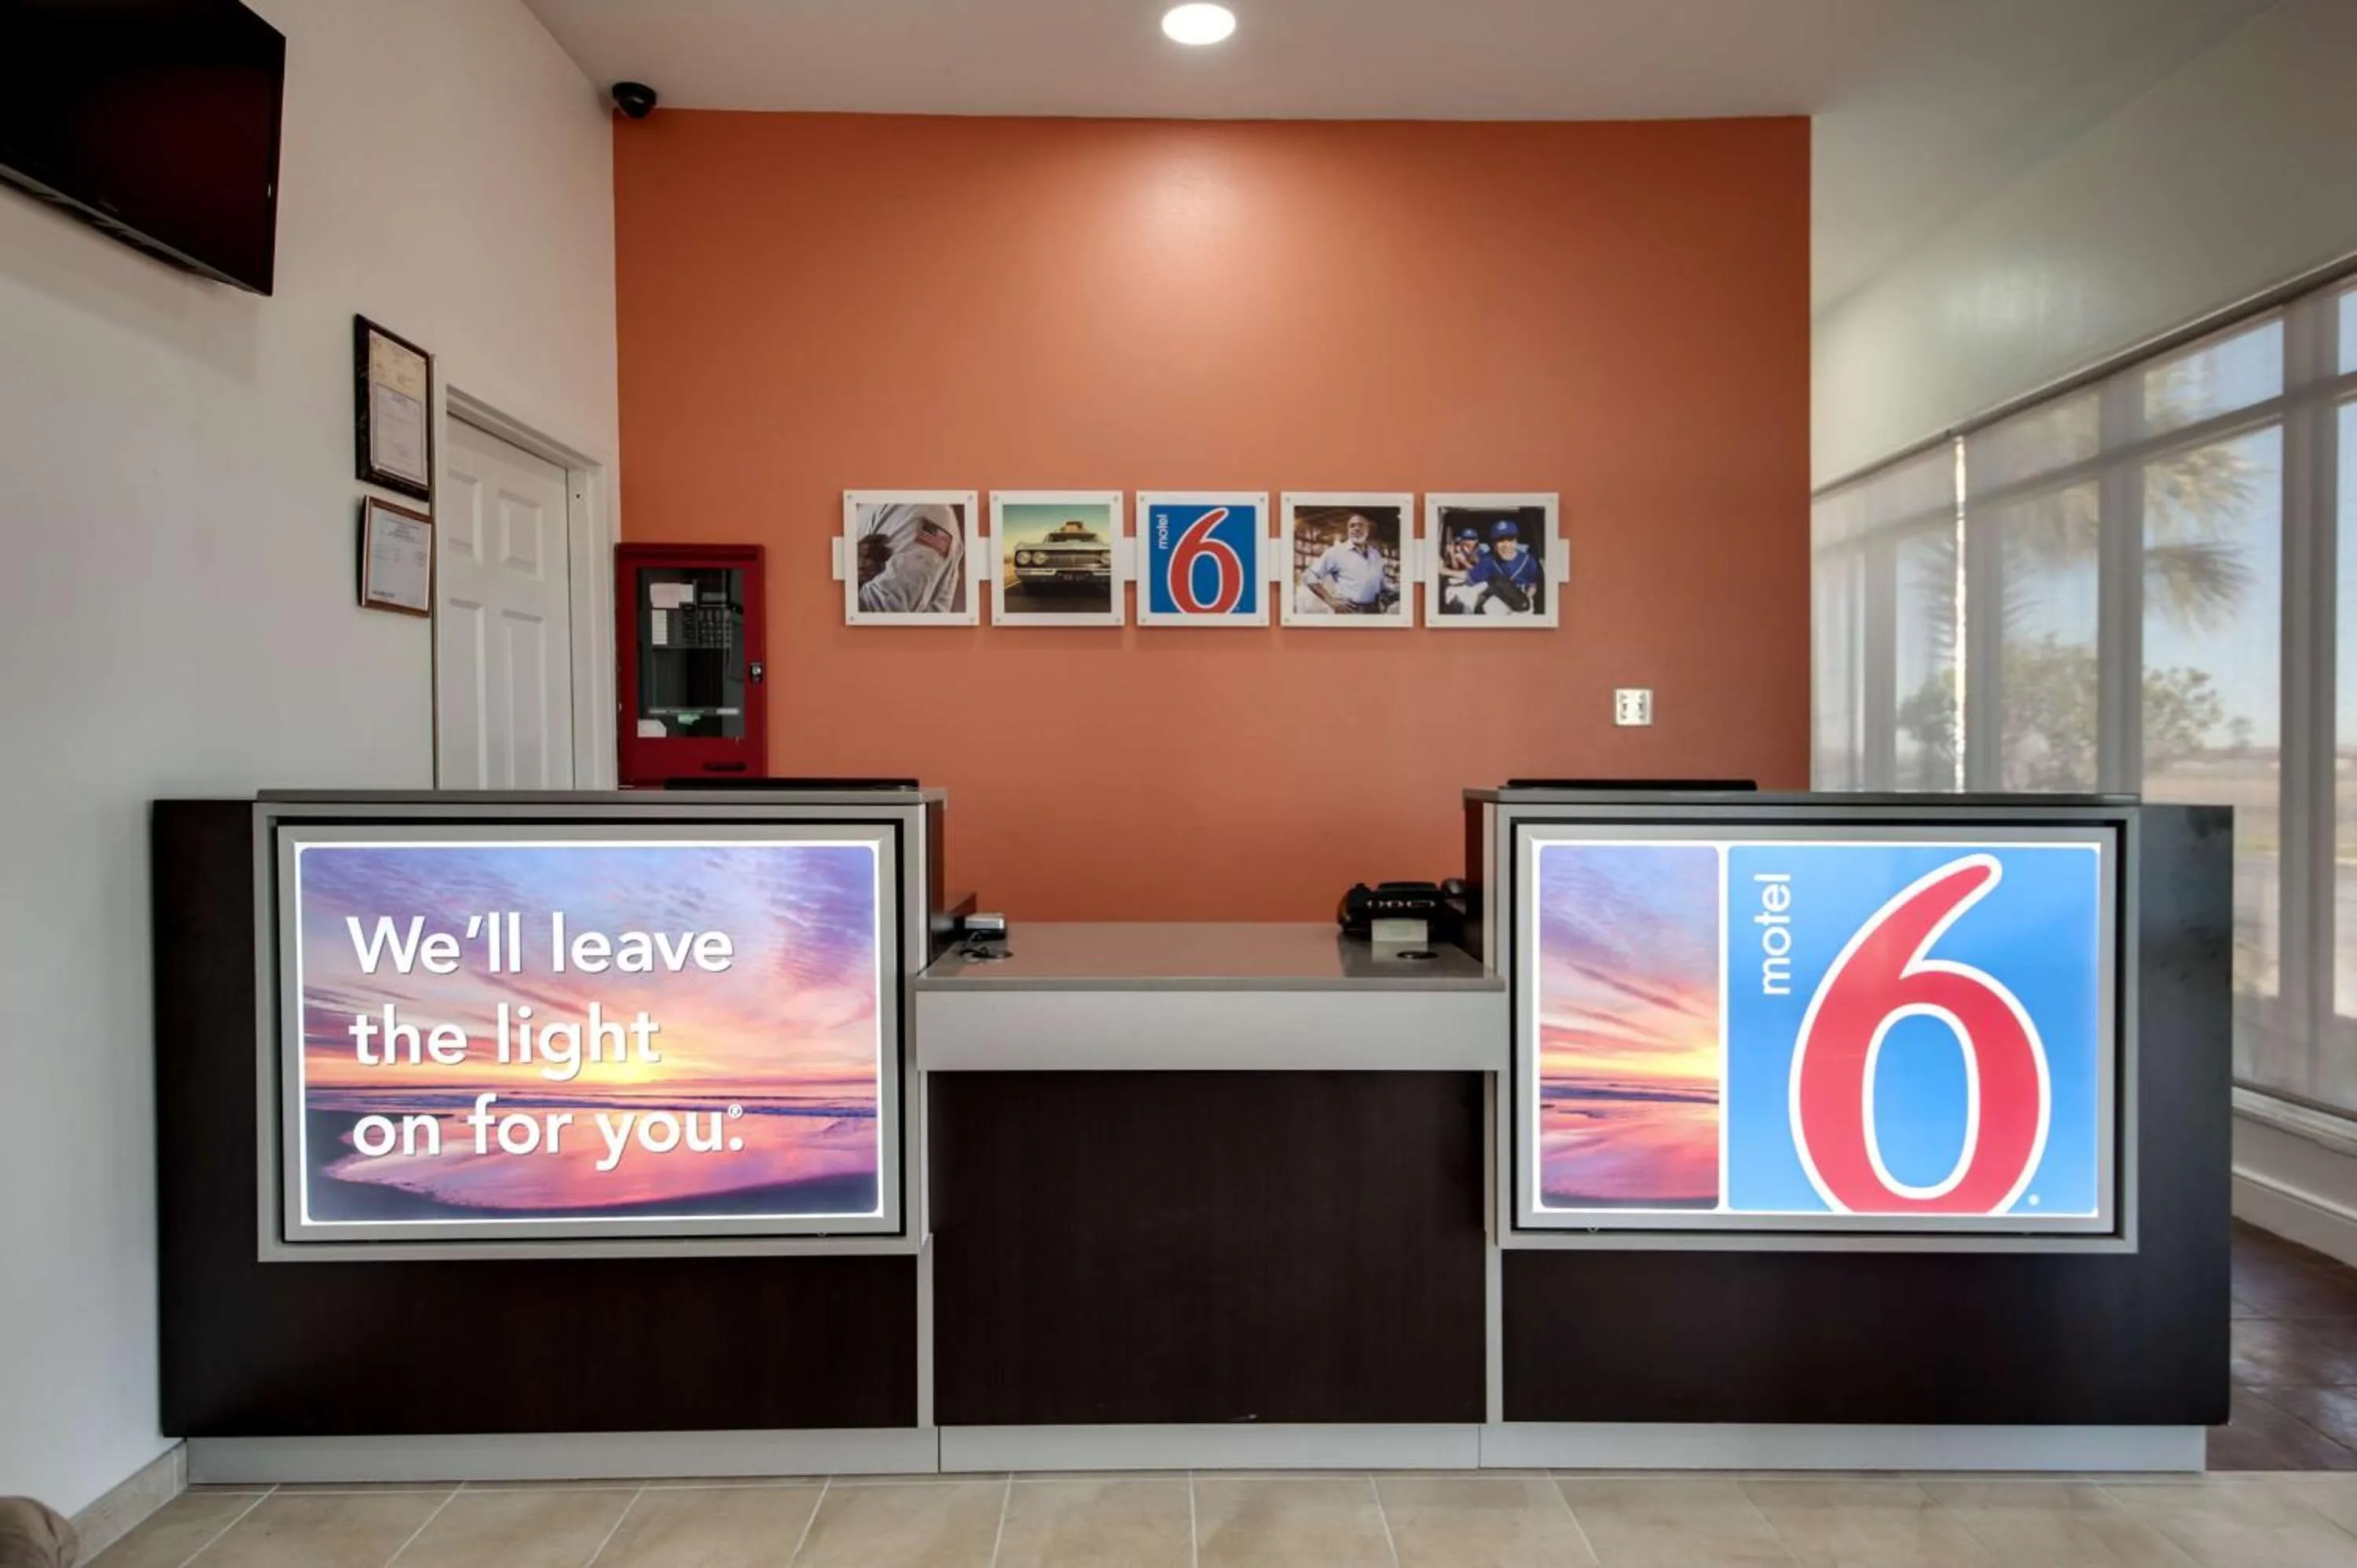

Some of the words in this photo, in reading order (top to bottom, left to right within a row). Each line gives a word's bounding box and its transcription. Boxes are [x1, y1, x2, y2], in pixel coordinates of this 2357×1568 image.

[1156, 514, 1169, 550] motel
[1167, 507, 1244, 614] 6
[346, 911, 522, 975] We'll
[552, 911, 735, 973] leave
[348, 1003, 468, 1065] the
[497, 1002, 661, 1082] light
[1754, 873, 1791, 995] motel
[1788, 853, 2051, 1214] 6
[353, 1114, 441, 1157] on
[467, 1093, 573, 1155] for
